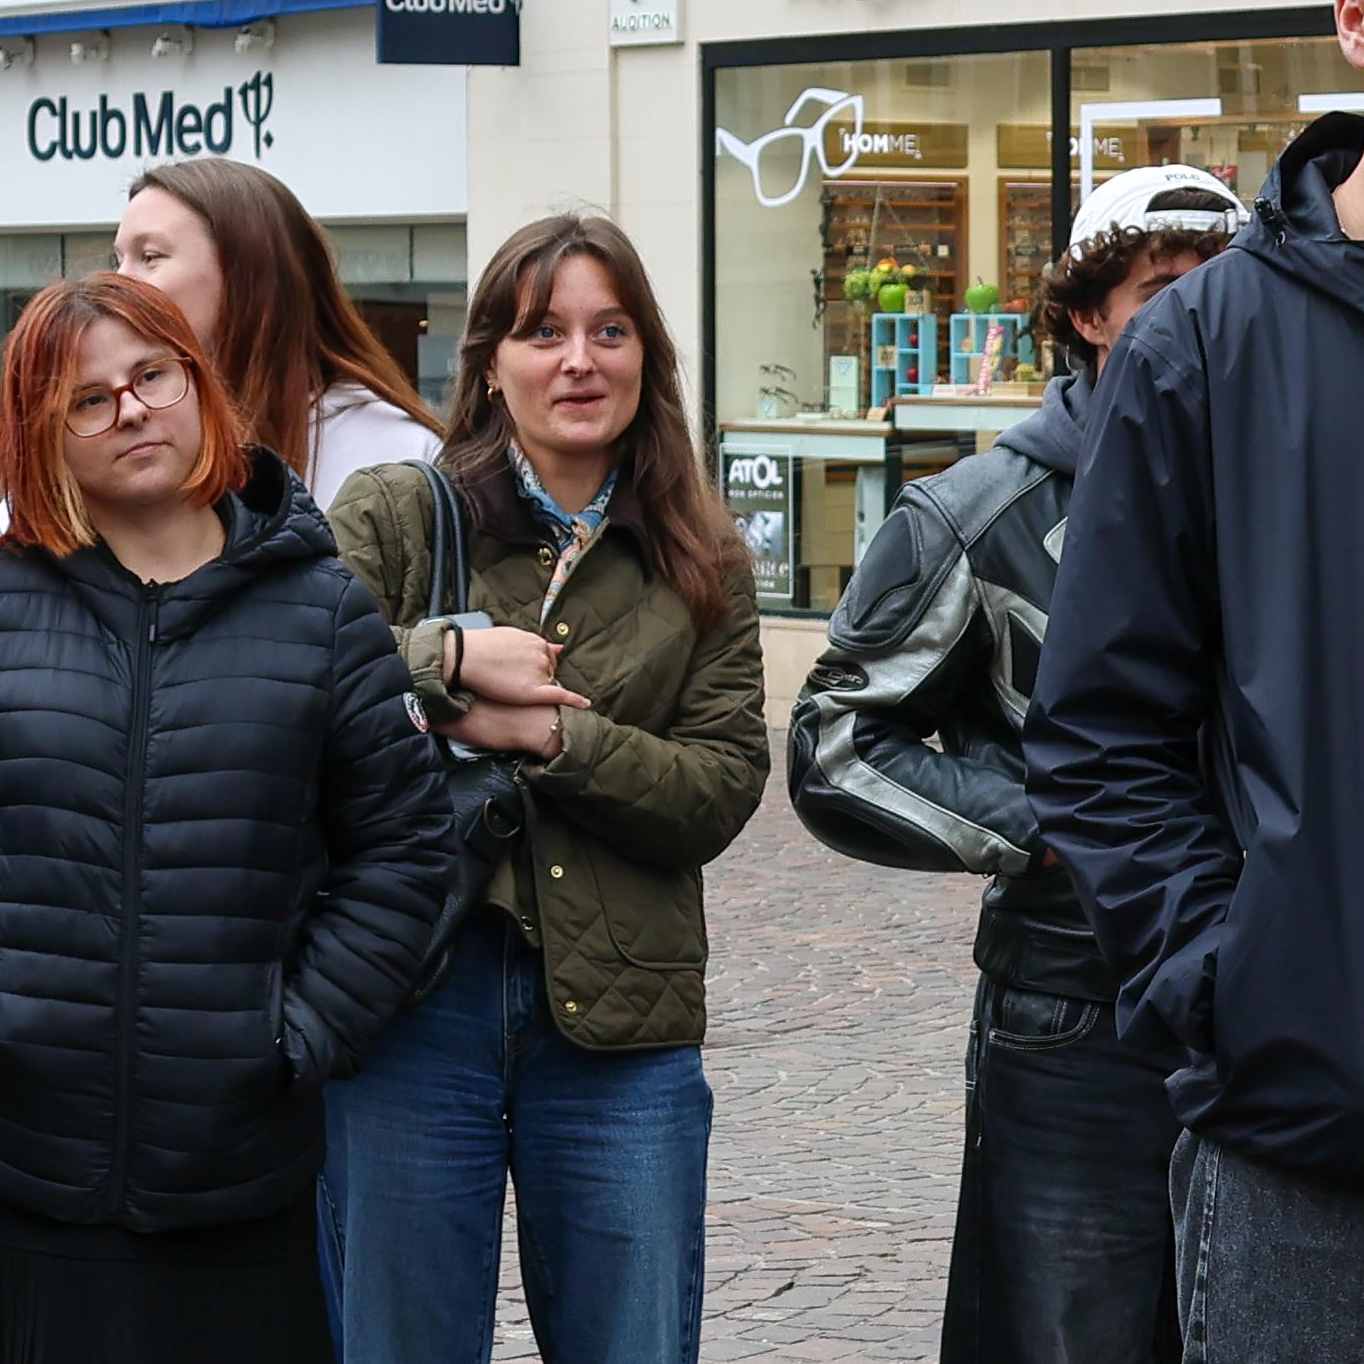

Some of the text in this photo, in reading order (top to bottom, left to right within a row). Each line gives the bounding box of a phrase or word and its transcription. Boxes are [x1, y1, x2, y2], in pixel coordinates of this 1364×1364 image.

[612, 12, 671, 31] AUDITION
[843, 133, 917, 155] HOMME
[728, 454, 784, 489] ATOL
